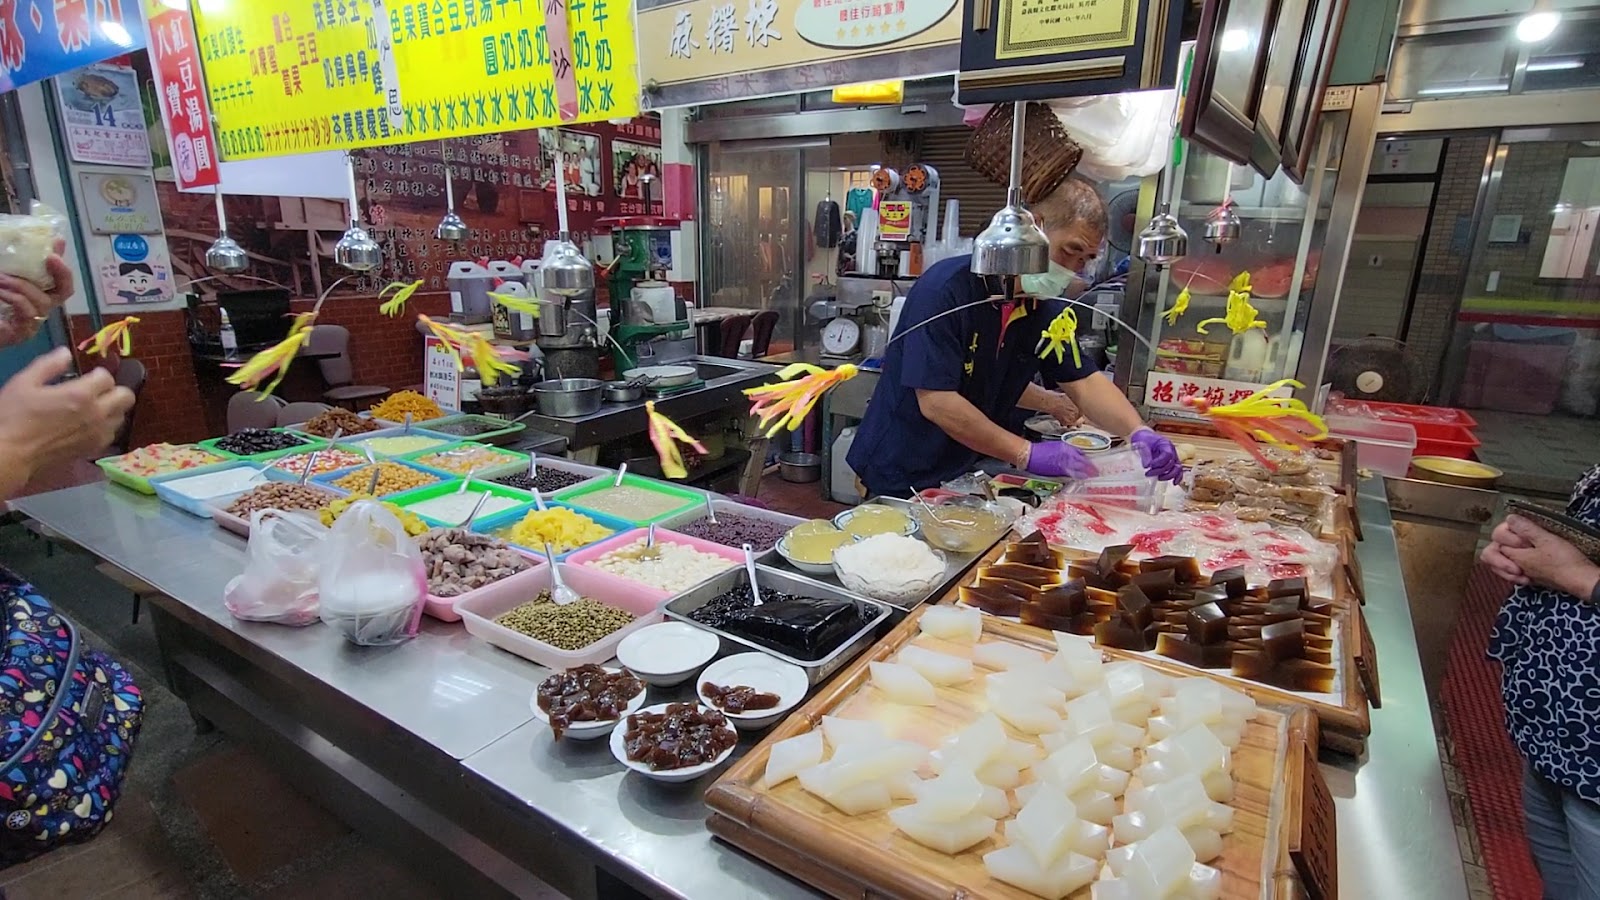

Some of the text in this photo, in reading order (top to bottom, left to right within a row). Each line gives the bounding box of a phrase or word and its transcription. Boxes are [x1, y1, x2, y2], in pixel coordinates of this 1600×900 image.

[92, 103, 117, 127] 14
[170, 16, 211, 171] 紅豆湯圓
